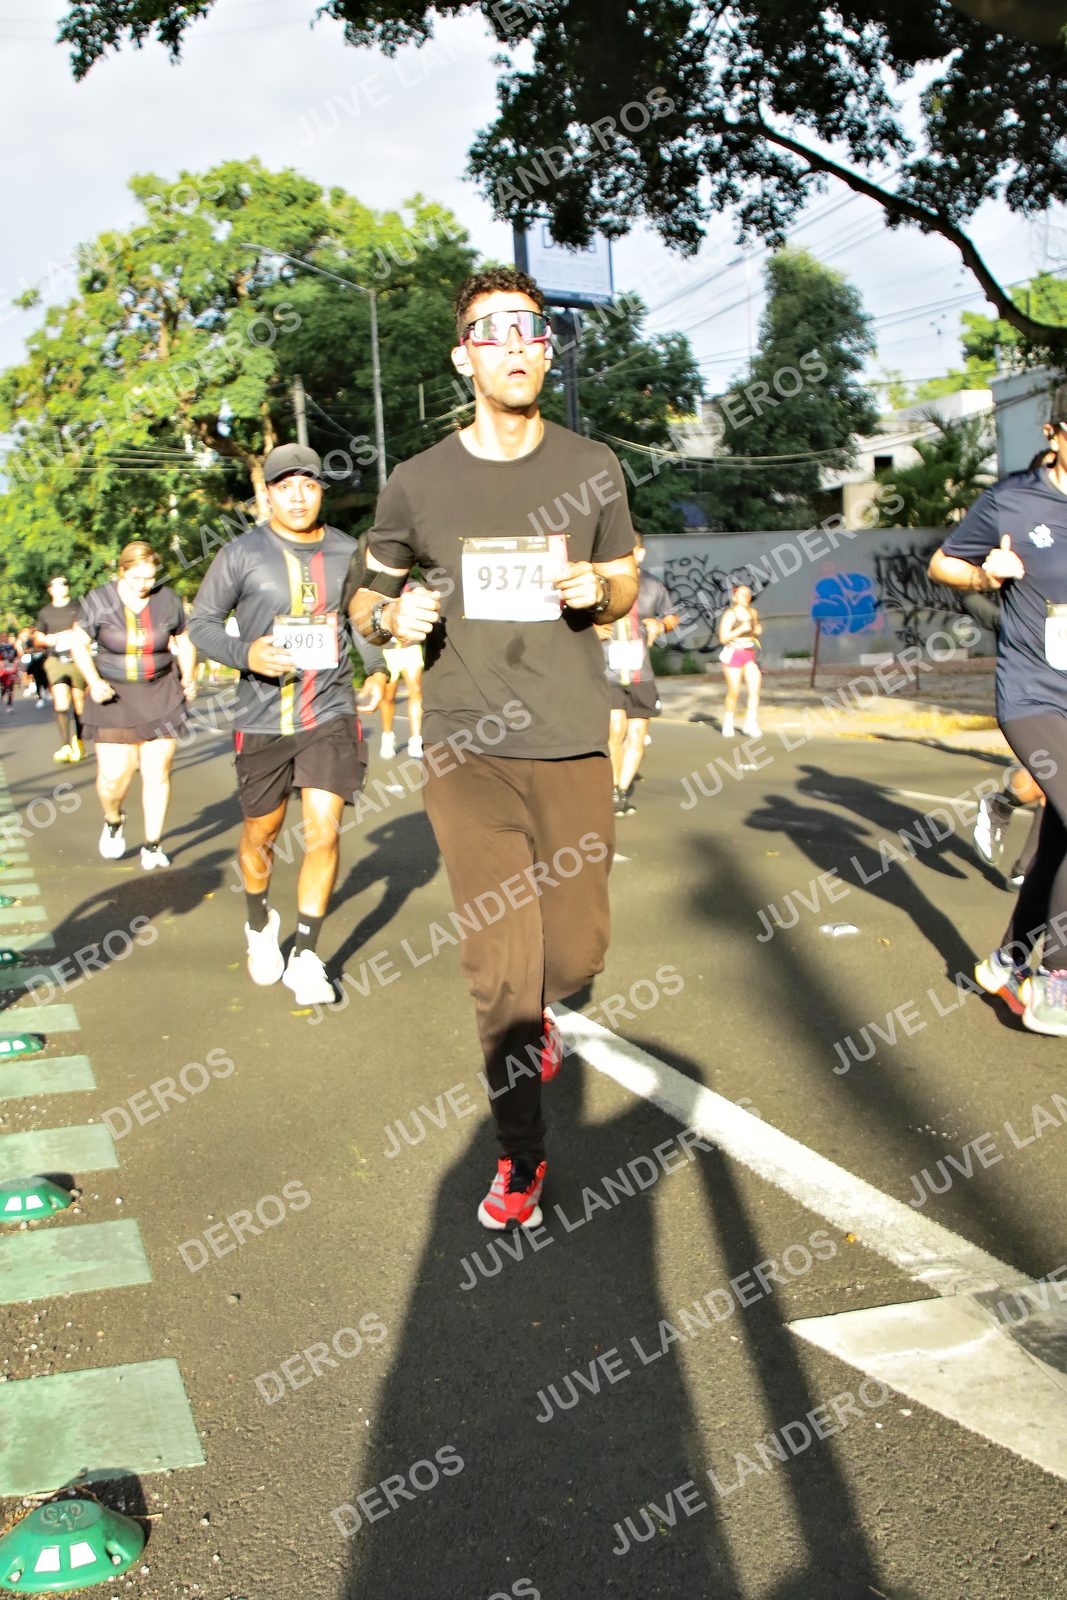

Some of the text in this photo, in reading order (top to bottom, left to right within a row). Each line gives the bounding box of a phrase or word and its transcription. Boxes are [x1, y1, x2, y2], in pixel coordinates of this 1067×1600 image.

[664, 554, 709, 570] TOY
[477, 565, 543, 590] 9374
[285, 633, 323, 649] 8903
